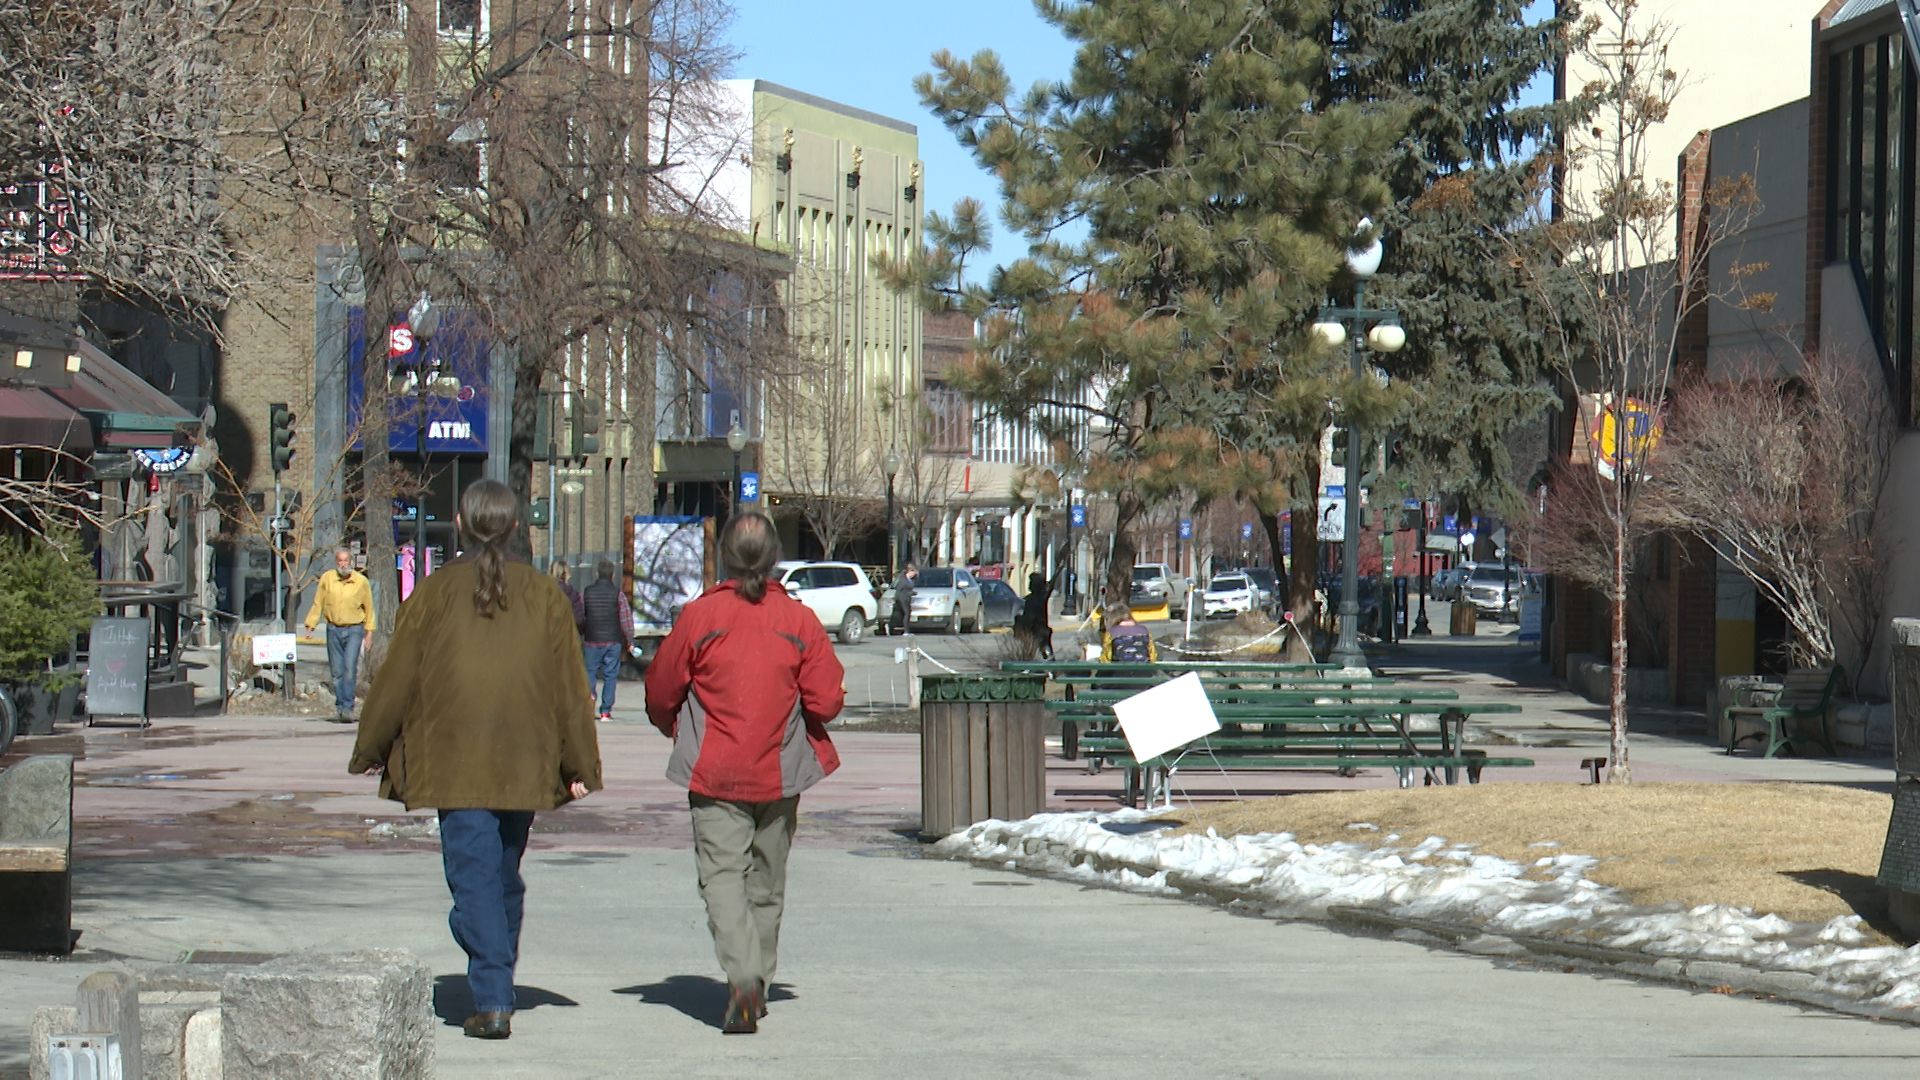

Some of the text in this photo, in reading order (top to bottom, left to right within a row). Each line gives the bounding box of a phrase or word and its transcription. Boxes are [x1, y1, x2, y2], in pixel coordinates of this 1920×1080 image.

[428, 421, 471, 438] ATM
[152, 451, 190, 472] CREAM
[1318, 524, 1342, 534] ONLY
